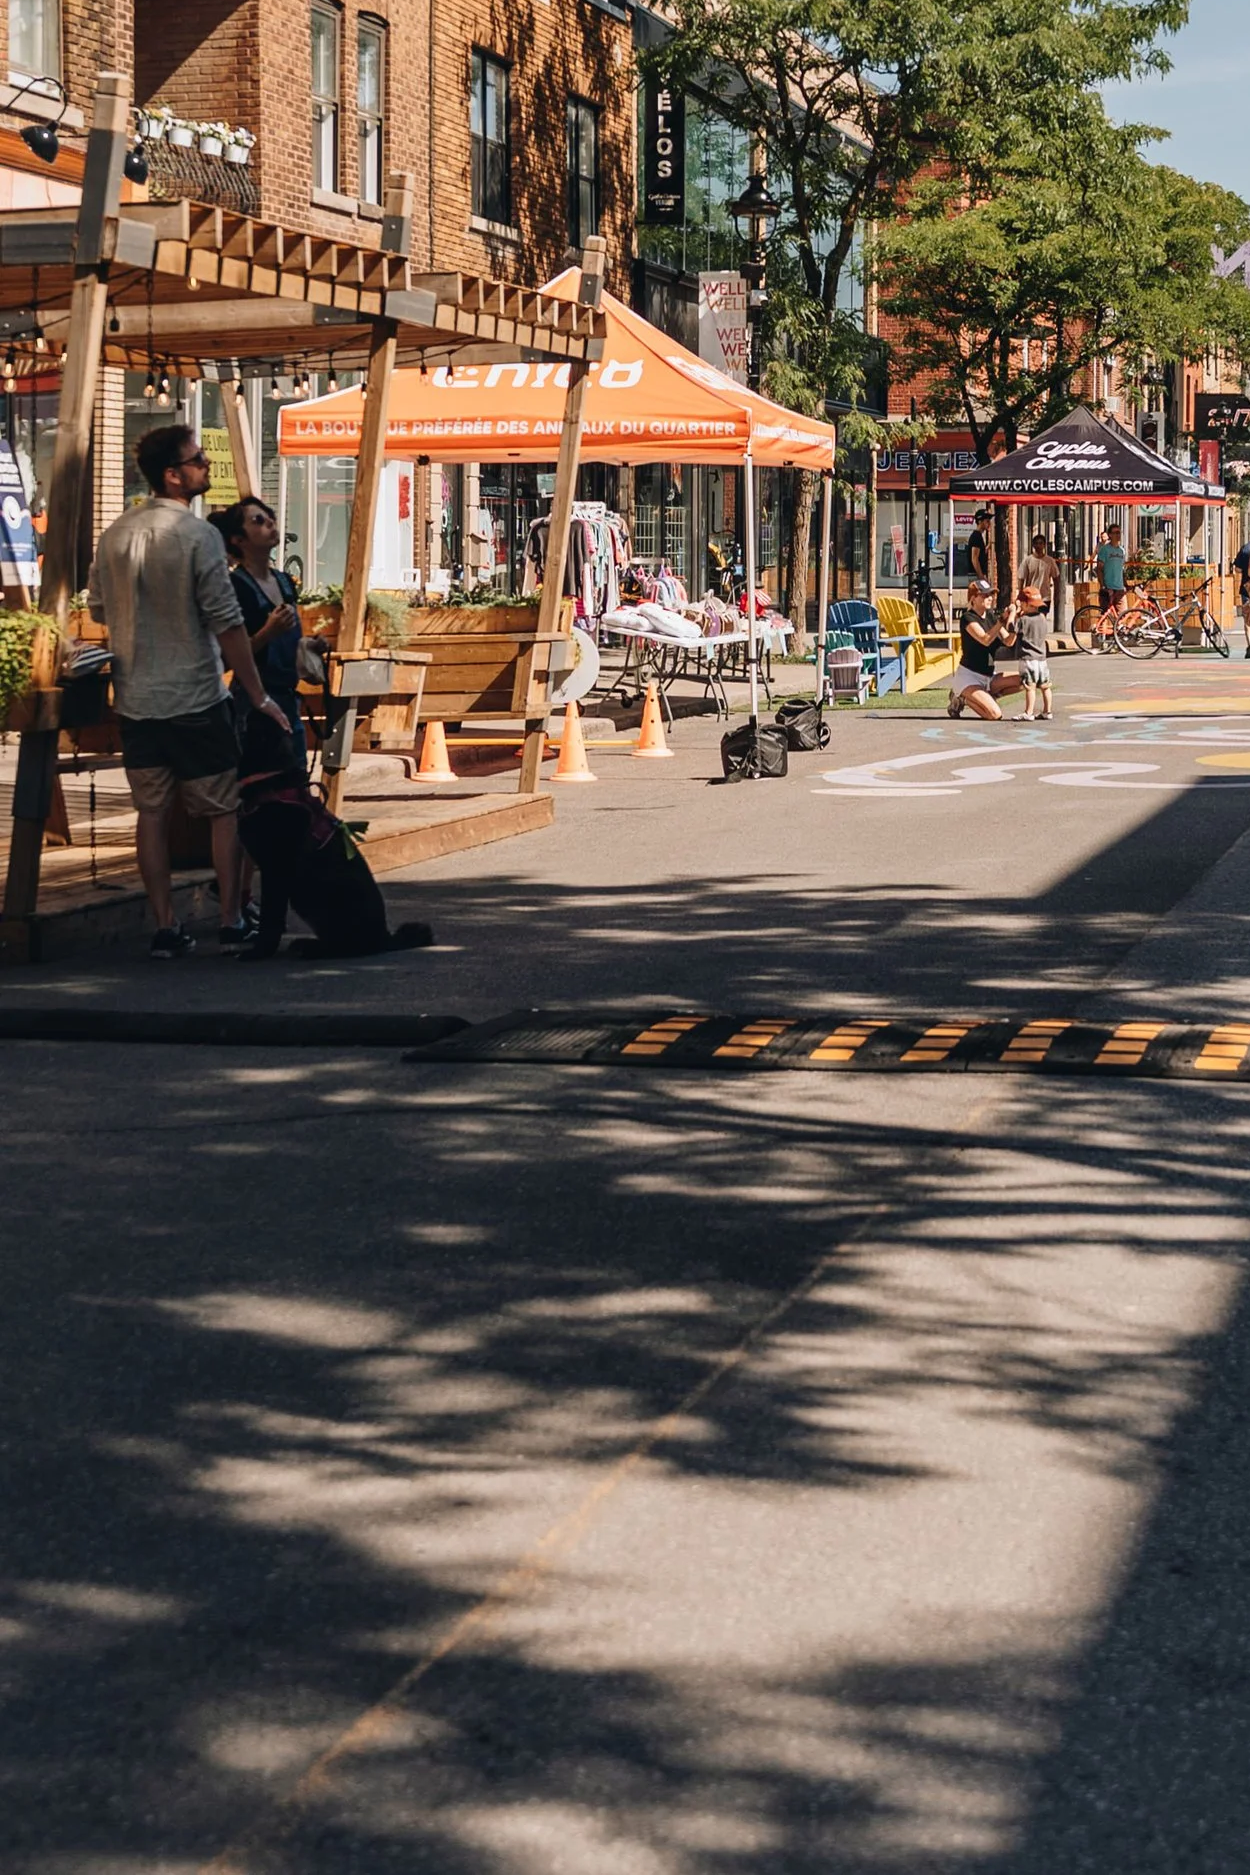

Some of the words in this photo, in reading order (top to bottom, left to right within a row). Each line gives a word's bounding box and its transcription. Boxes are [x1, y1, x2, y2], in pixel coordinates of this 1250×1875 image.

[296, 421, 318, 436] LA
[322, 420, 408, 436] BOUUE
[412, 417, 492, 436] PRÉFÉRÉE
[496, 420, 529, 435] DES
[533, 421, 615, 435] ANIAUX
[620, 421, 645, 435] DU
[650, 421, 737, 436] QUARTIER
[1036, 441, 1107, 459] Cycles
[1025, 456, 1112, 472] Campus
[973, 479, 1154, 493] WWW.CYCLESCAMPUS.COM
